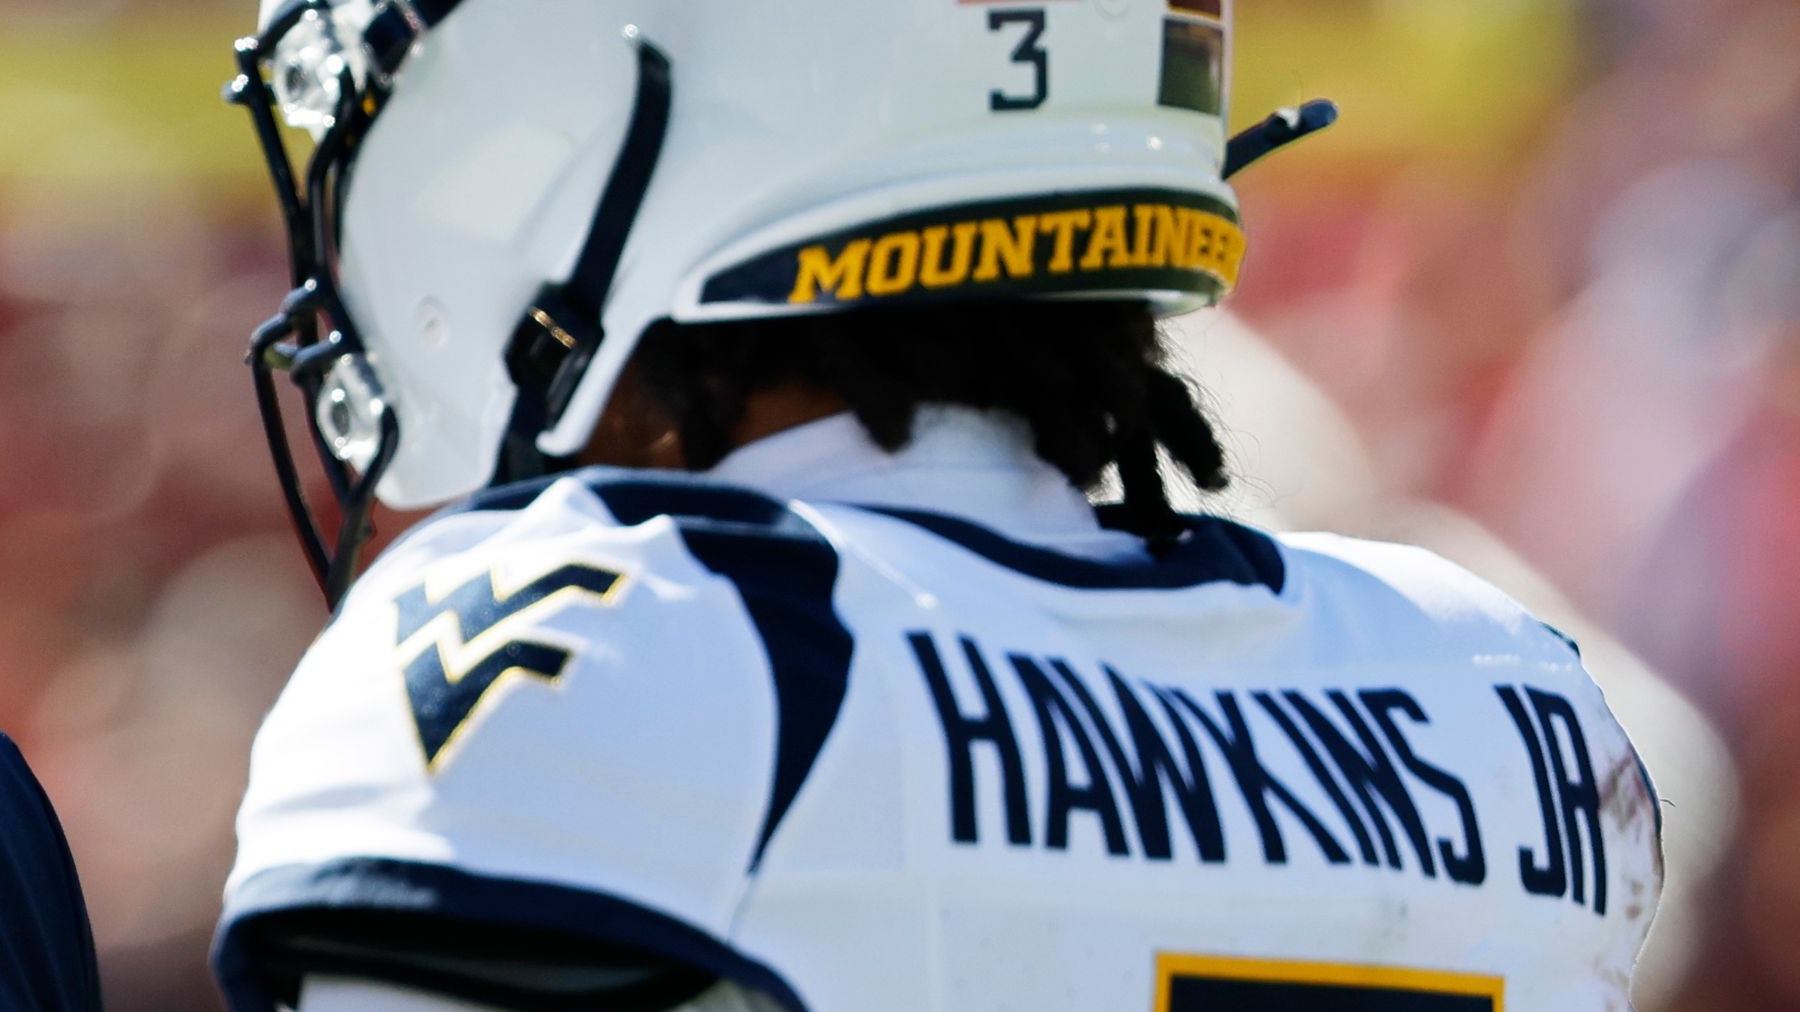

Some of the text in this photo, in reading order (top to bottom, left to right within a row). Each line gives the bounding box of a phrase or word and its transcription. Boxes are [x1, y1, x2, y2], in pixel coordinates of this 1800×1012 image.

[987, 8, 1049, 112] 3
[905, 630, 1608, 916] HAWKINS JR
